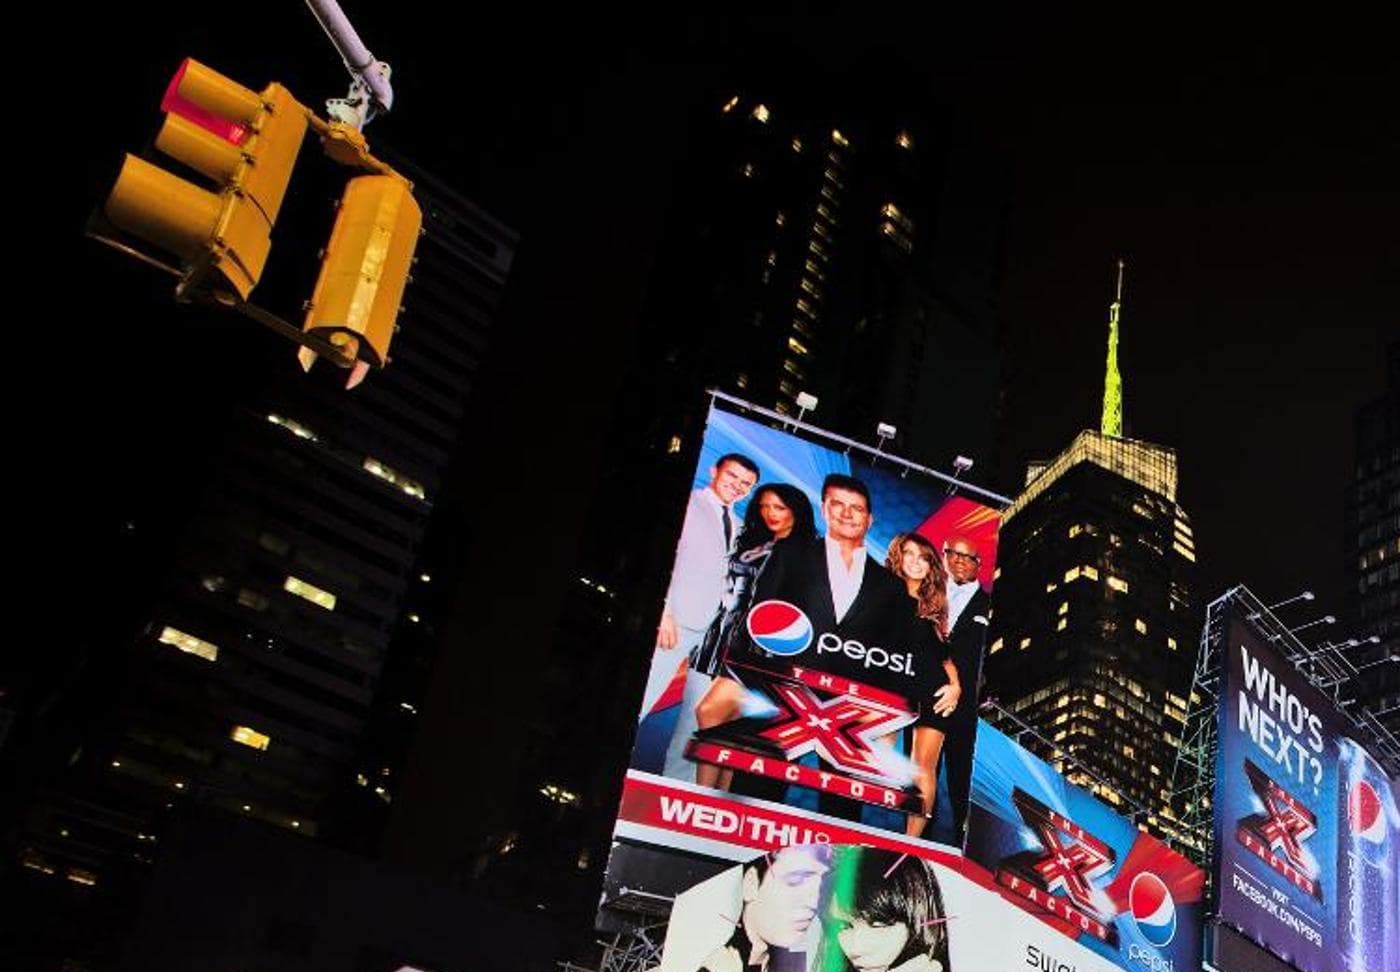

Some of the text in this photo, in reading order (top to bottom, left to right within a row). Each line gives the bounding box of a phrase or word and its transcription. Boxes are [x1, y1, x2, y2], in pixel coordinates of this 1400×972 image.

[792, 667, 859, 695] THE
[1241, 645, 1324, 751] WHO'S
[1239, 691, 1323, 795] NEXT?
[717, 751, 897, 806] FACTOR
[1050, 812, 1084, 839] THE
[1010, 879, 1107, 939] FACTOR
